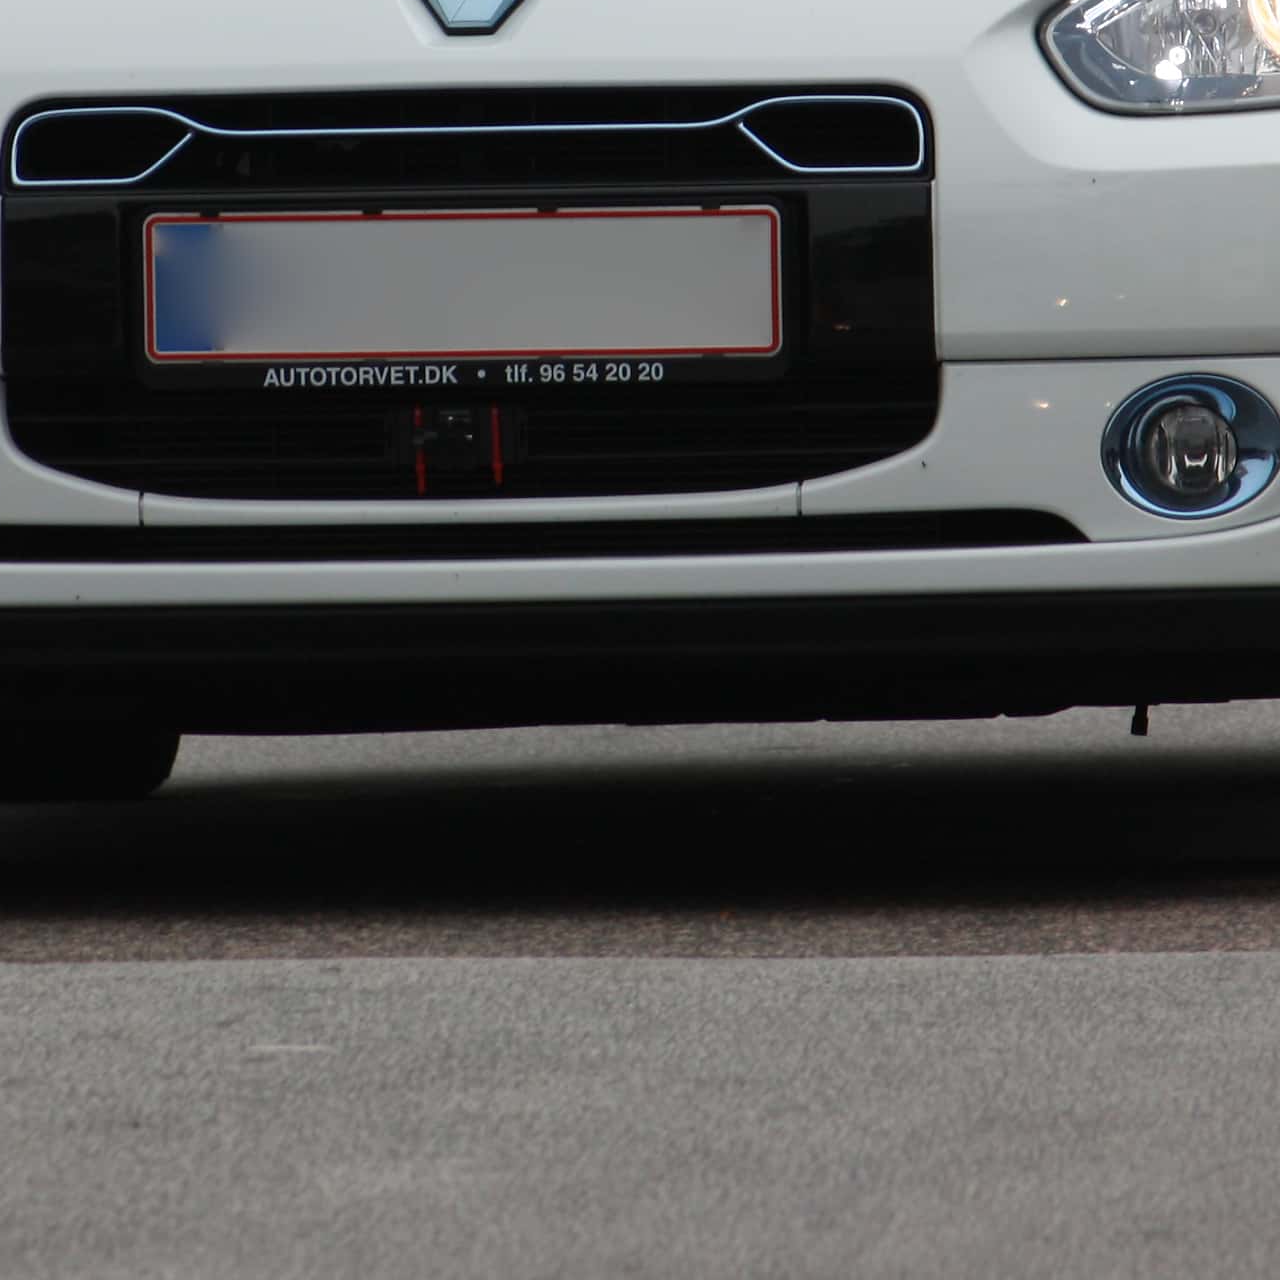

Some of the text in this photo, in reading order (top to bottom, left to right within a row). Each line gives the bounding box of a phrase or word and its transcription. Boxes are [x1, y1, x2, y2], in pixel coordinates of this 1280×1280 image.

[263, 362, 664, 387] AUTOTORVET.DK tlf. 96 54 20 20
